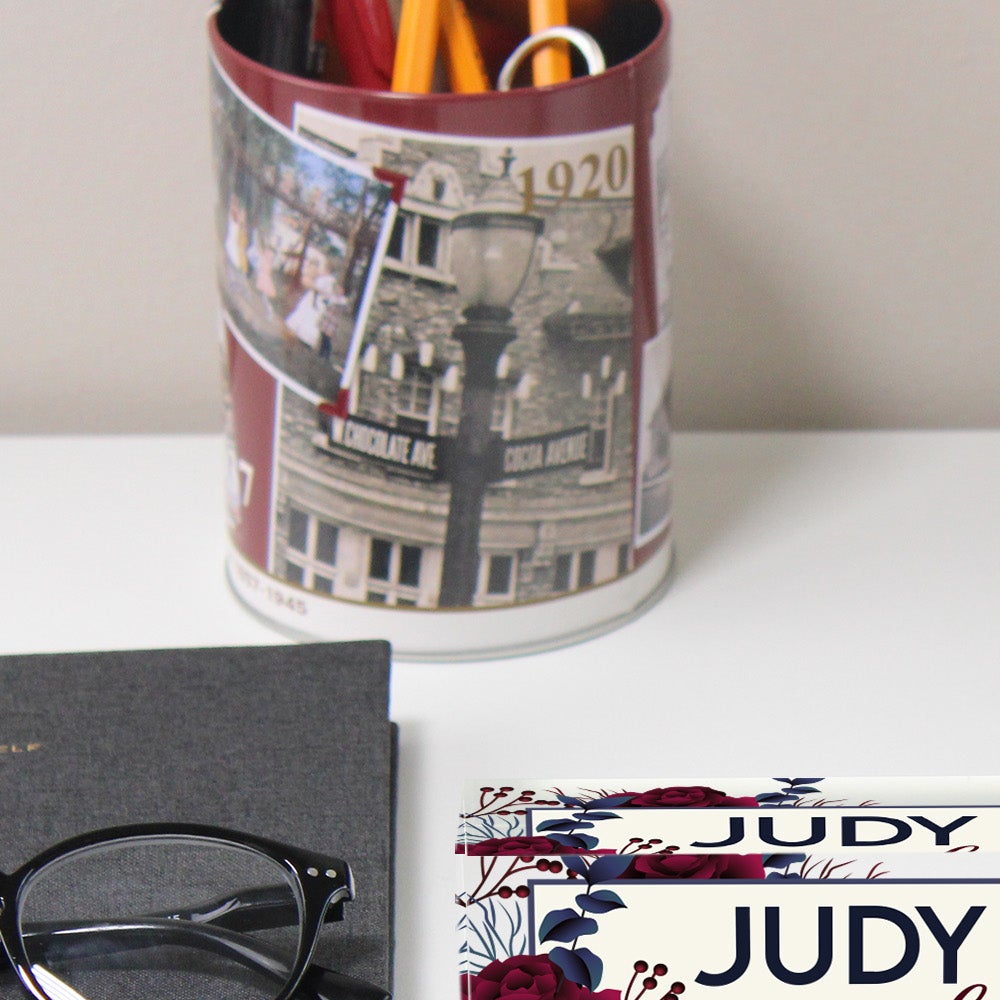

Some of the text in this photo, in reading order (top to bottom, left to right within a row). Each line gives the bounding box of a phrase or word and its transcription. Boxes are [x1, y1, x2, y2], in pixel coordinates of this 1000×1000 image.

[517, 144, 628, 214] 1920
[344, 419, 412, 465] CHOCOLATE
[690, 815, 979, 848] JUDY
[694, 905, 987, 987] JUDY
